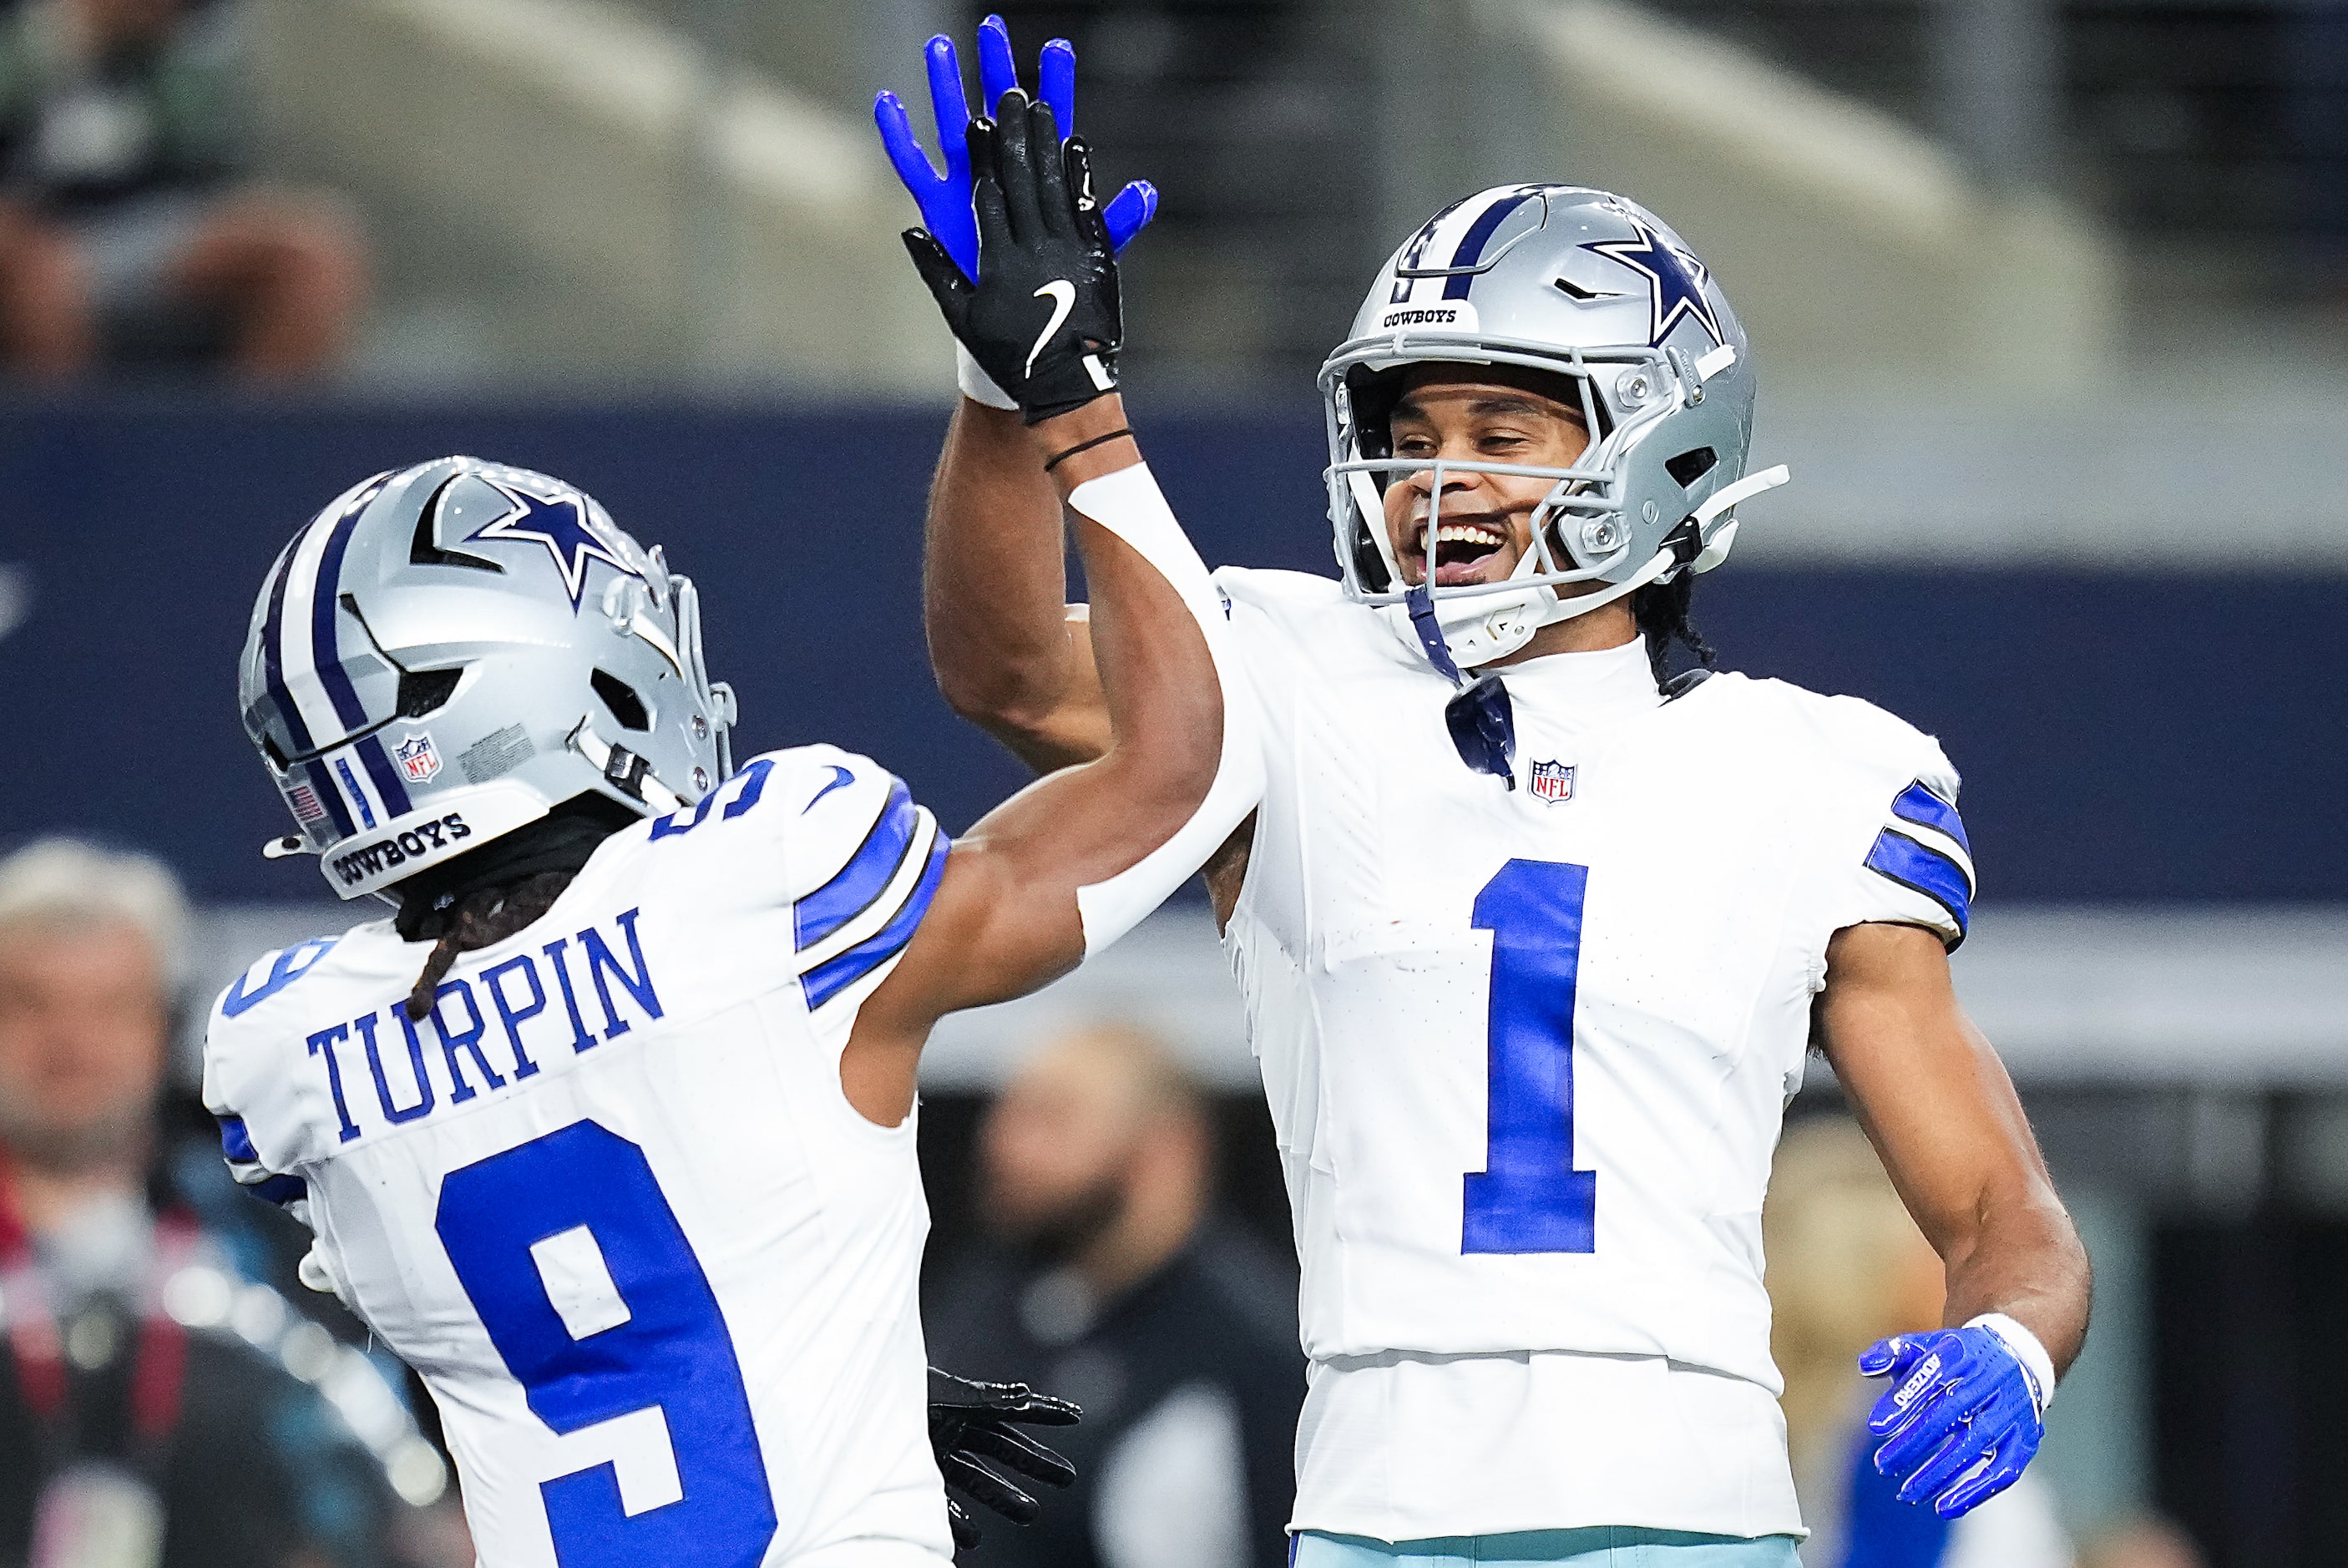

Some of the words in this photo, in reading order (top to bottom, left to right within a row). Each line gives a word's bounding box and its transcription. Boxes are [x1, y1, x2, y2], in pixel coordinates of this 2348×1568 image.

[1384, 310, 1456, 327] COWBOYS
[405, 753, 436, 776] NFL
[1536, 776, 1568, 797] NFL
[306, 907, 665, 1144] TURPIN
[1461, 857, 1596, 1255] 1
[435, 1117, 778, 1568] 9
[1893, 1353, 1941, 1408] ADIZERO
